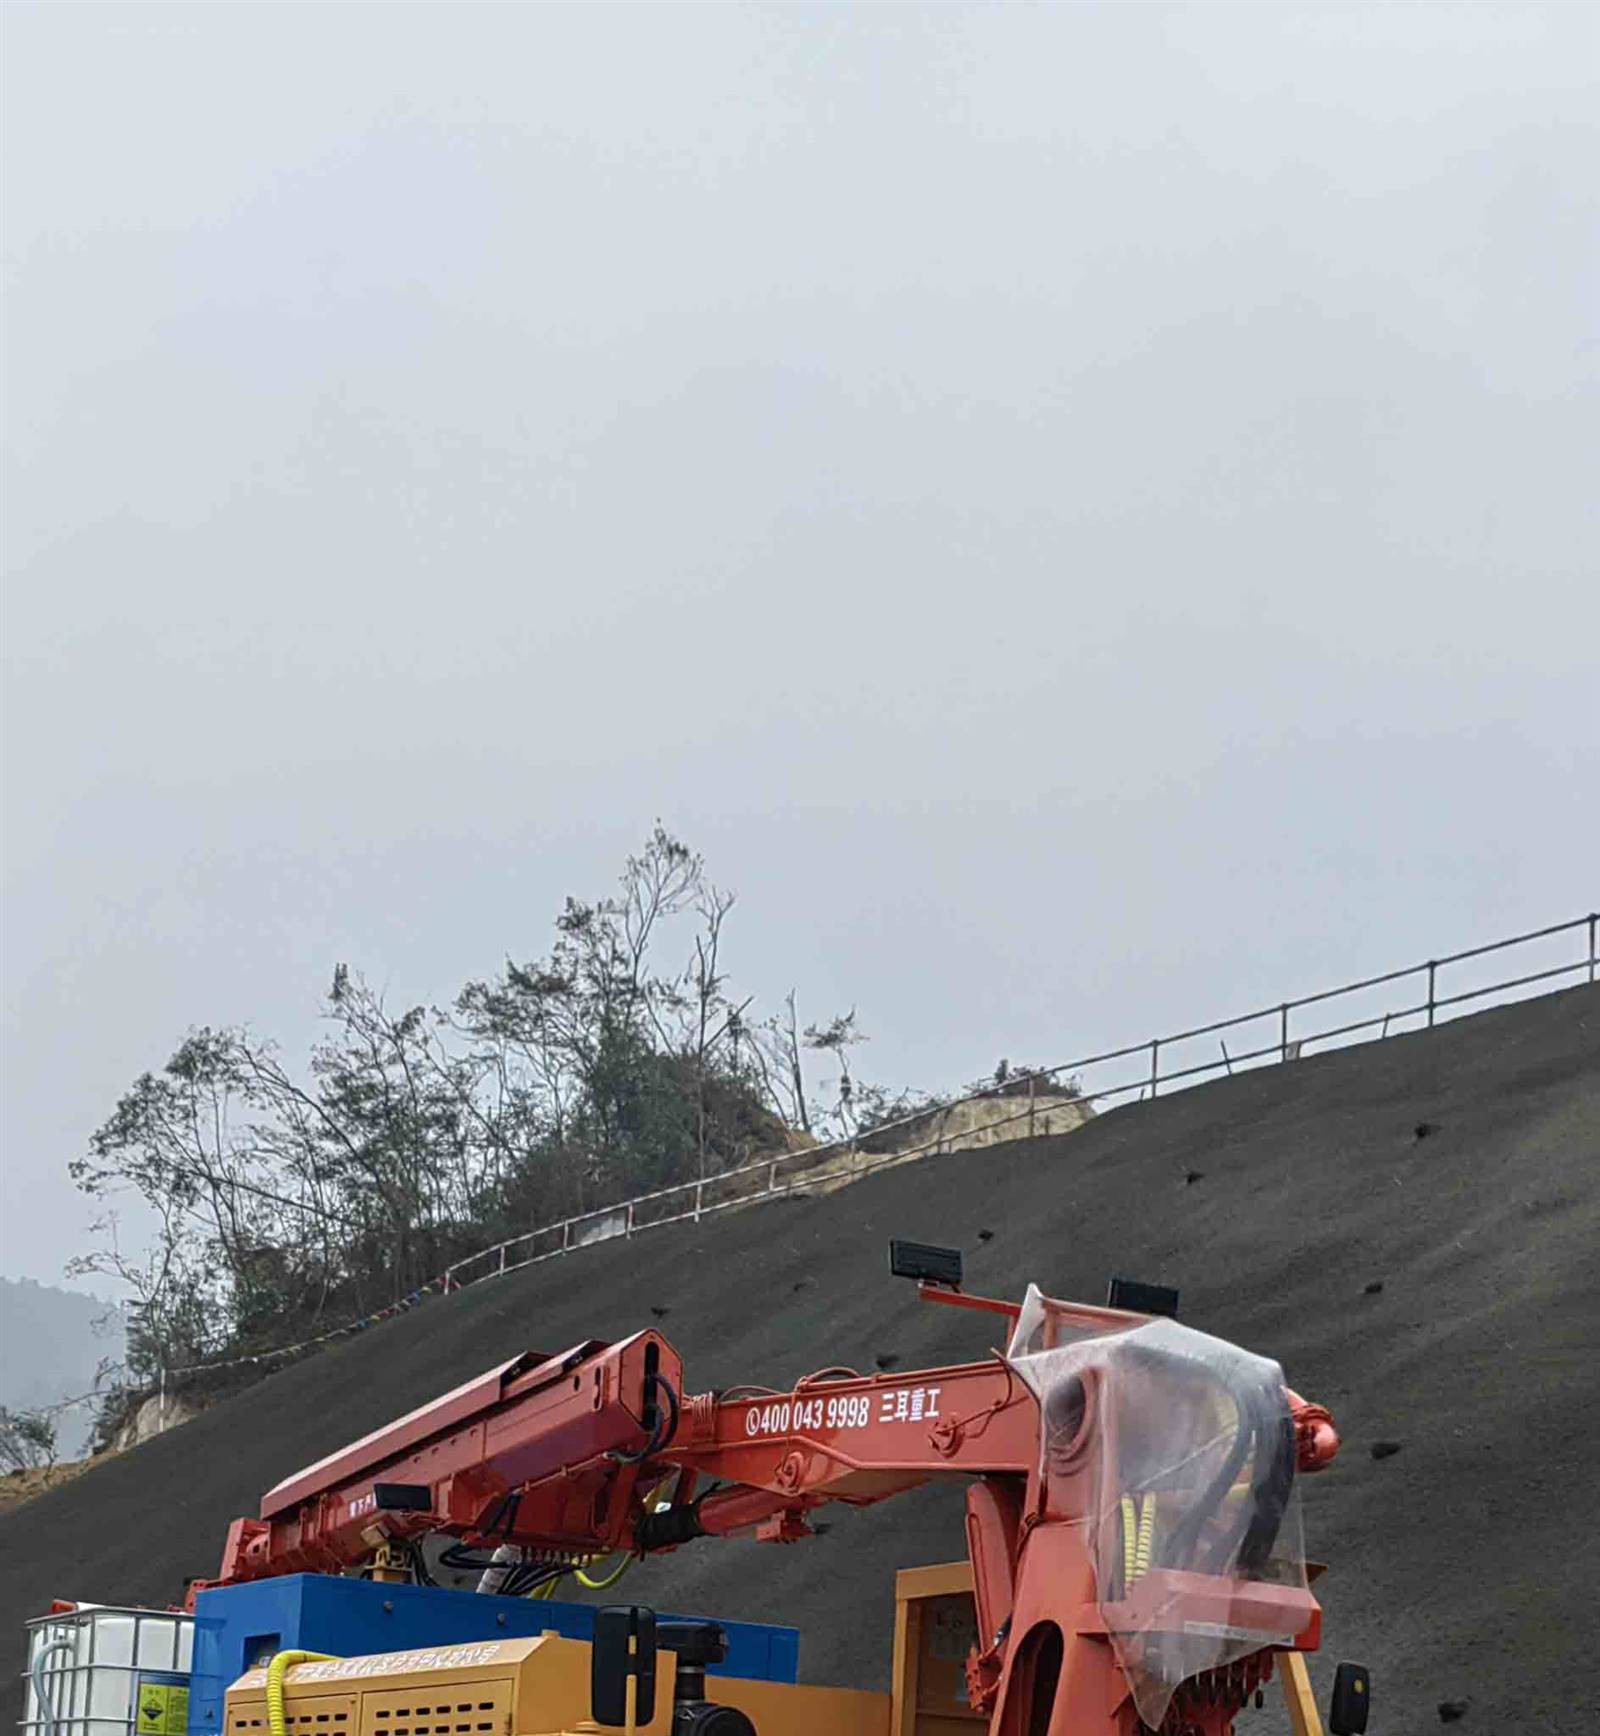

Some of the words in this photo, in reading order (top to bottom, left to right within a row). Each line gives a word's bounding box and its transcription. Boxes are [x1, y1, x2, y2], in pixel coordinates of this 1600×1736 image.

[760, 1403, 790, 1435] 400
[792, 1398, 823, 1430] 043
[826, 1396, 871, 1428] 9998
[878, 1388, 942, 1423] 三耳重工
